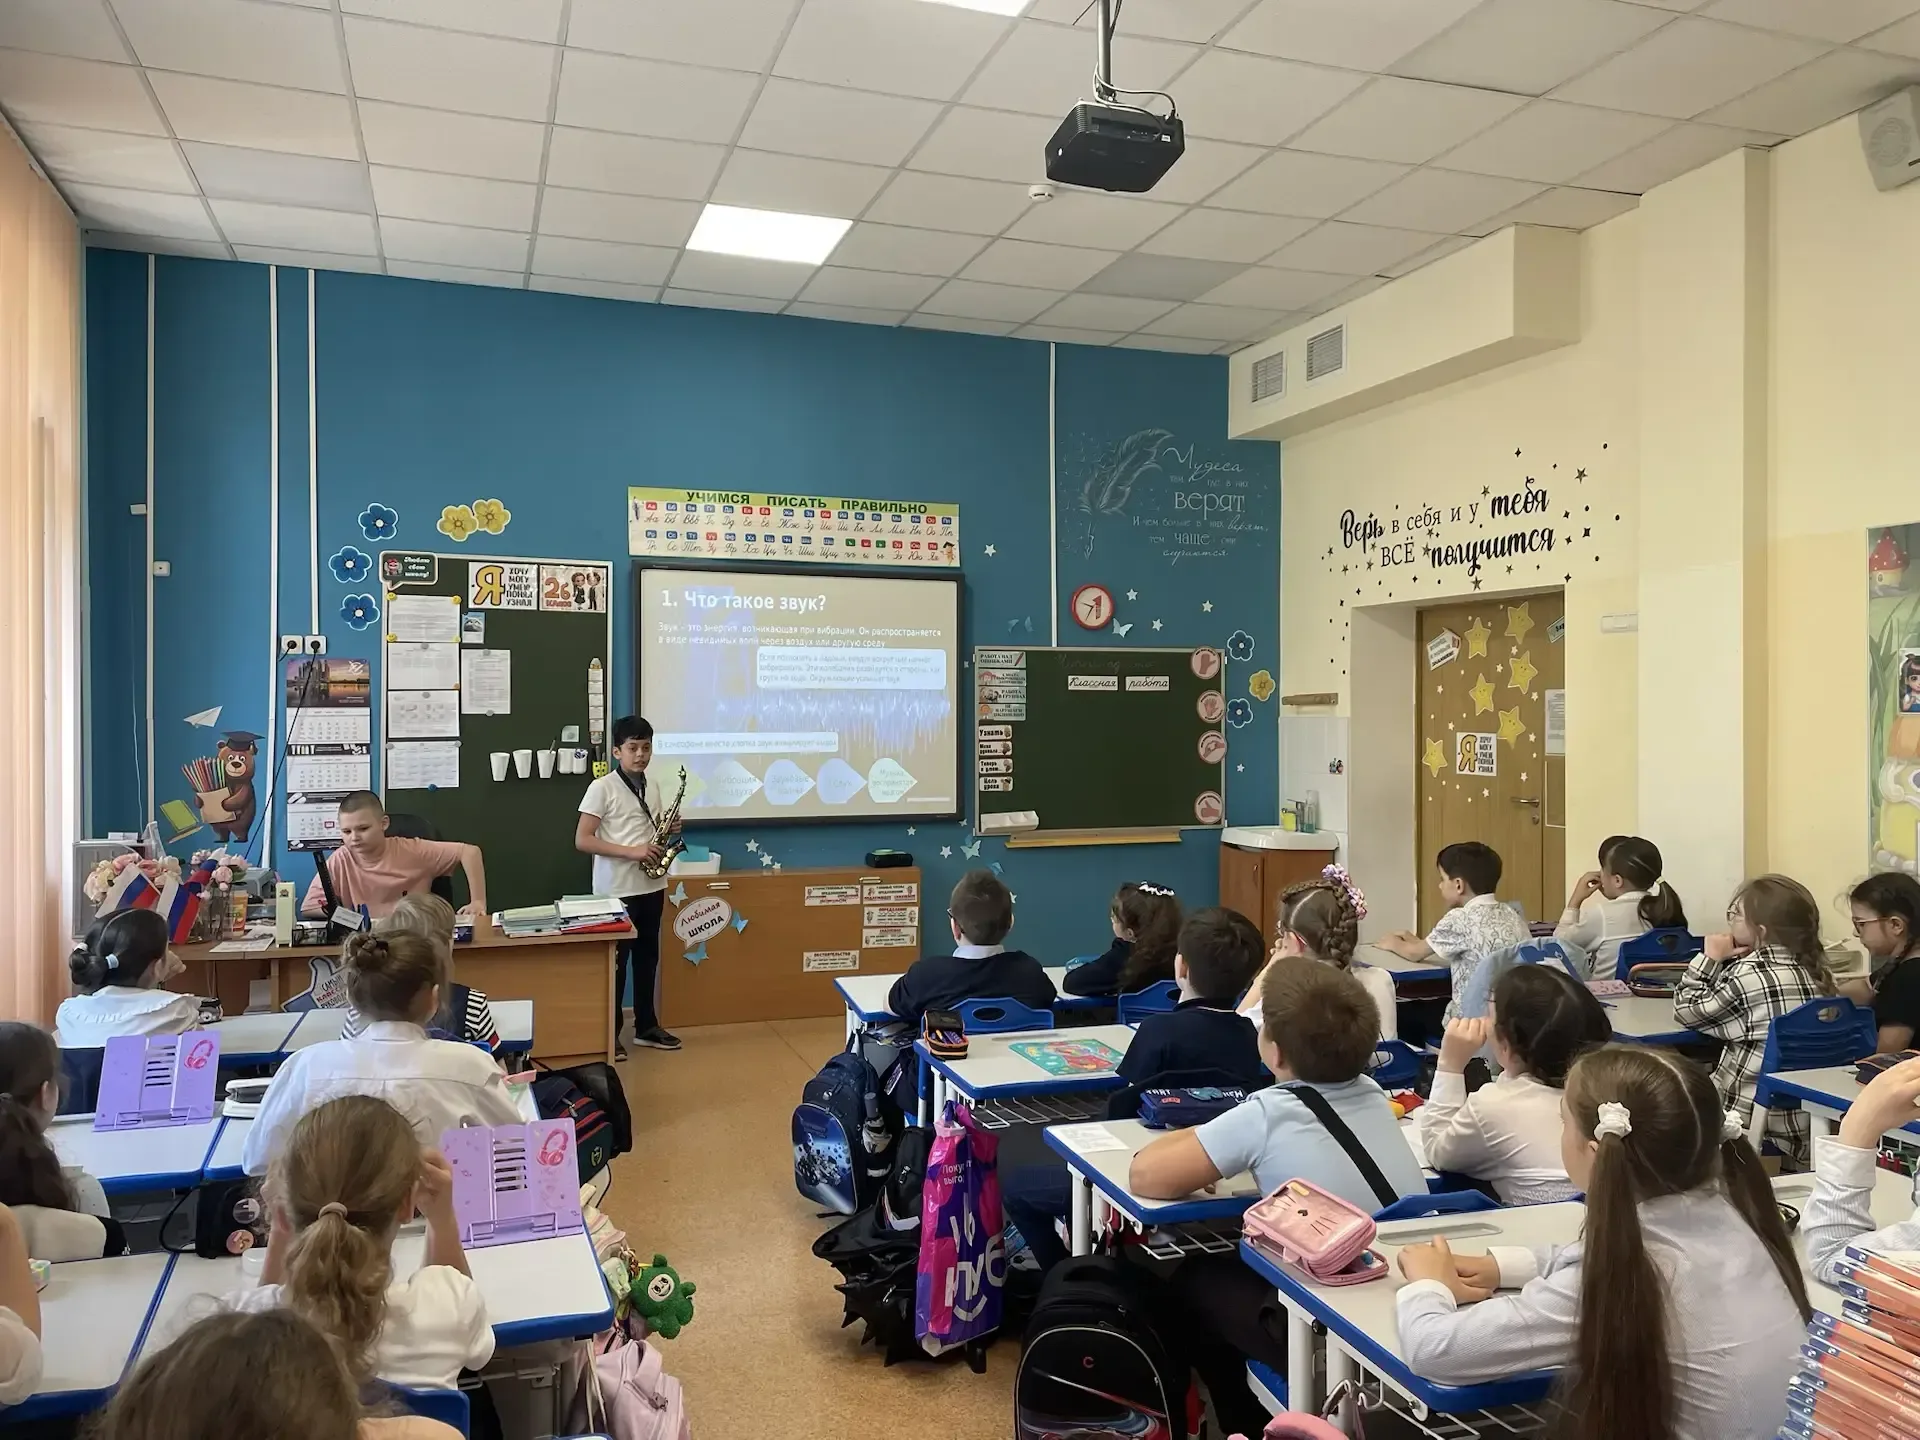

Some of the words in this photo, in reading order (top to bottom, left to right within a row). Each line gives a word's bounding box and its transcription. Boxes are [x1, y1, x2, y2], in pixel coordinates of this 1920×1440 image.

[1162, 443, 1244, 482] Чудеса
[686, 491, 750, 505] УЧИМСЯ
[767, 496, 827, 508] ПИСАТЬ
[841, 500, 928, 514] ПРАВИЛЬНО
[1341, 509, 1385, 553] Верь
[1391, 519, 1399, 534] в
[1406, 507, 1441, 531] себя
[1450, 507, 1461, 523] и
[1469, 502, 1480, 523] у
[1491, 476, 1549, 519] тебя
[1381, 536, 1416, 567] ВСЁ
[1431, 527, 1556, 576] получится
[473, 565, 505, 606] Я
[661, 589, 678, 607] 1.
[685, 590, 718, 609] Что
[723, 594, 774, 610] такое
[780, 594, 827, 614] звук?
[658, 621, 678, 633] Звук
[688, 624, 701, 632] это
[742, 625, 798, 634] возникающая
[800, 626, 815, 635] при
[859, 626, 870, 636] Он
[871, 627, 942, 638] распространяется
[666, 636, 687, 645] виде
[690, 637, 737, 645] невидимых
[761, 637, 784, 646] через
[832, 638, 860, 648] другую
[863, 639, 886, 649] среду
[1069, 676, 1117, 687] Классная
[1459, 734, 1478, 772] Я
[680, 902, 721, 927] Любимая
[688, 915, 725, 938] ШКОЛА
